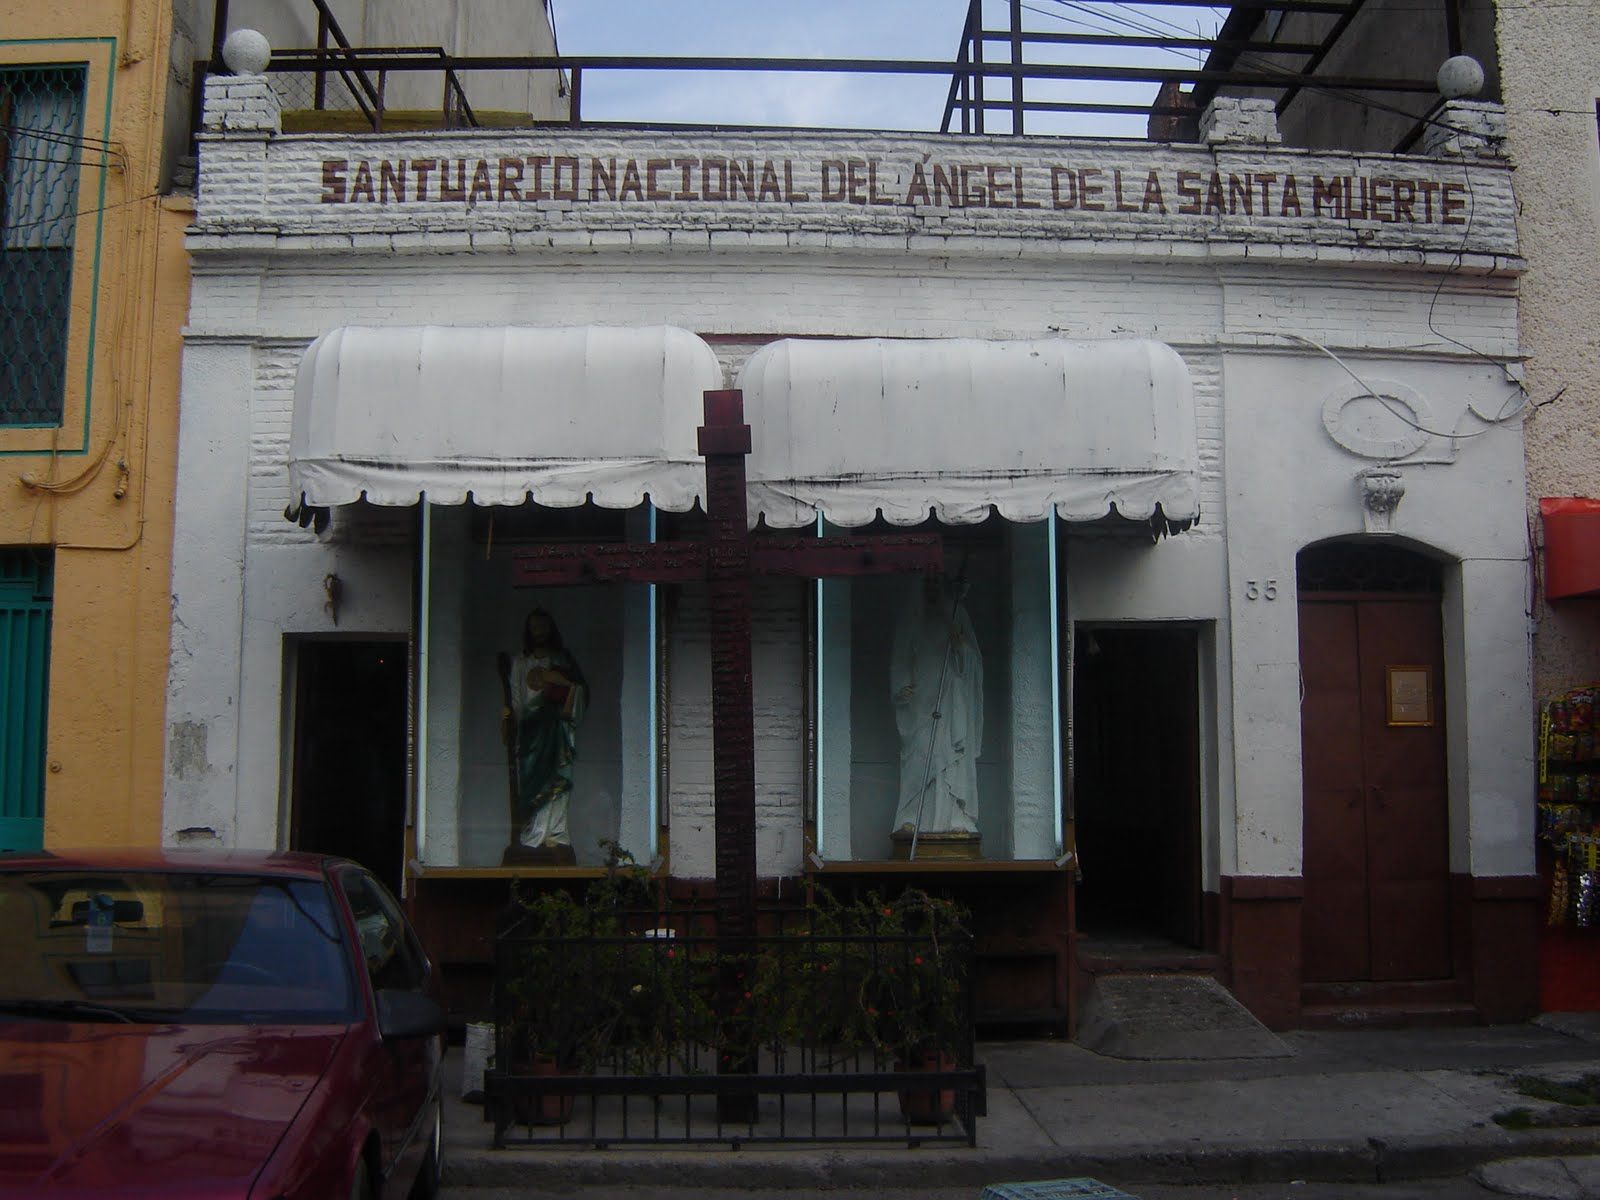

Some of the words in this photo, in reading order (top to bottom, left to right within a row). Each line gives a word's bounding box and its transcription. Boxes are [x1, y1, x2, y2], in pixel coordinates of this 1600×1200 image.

[321, 156, 578, 204] SANTUARIO
[591, 157, 809, 203] NACIONAL
[821, 159, 894, 205] DEL
[906, 153, 1041, 208] ÁNGEL
[1051, 166, 1105, 211] DE
[1114, 170, 1167, 214] LA
[1177, 171, 1301, 217] SANTA
[1312, 175, 1466, 224] MUERTE
[1246, 580, 1278, 601] 35
